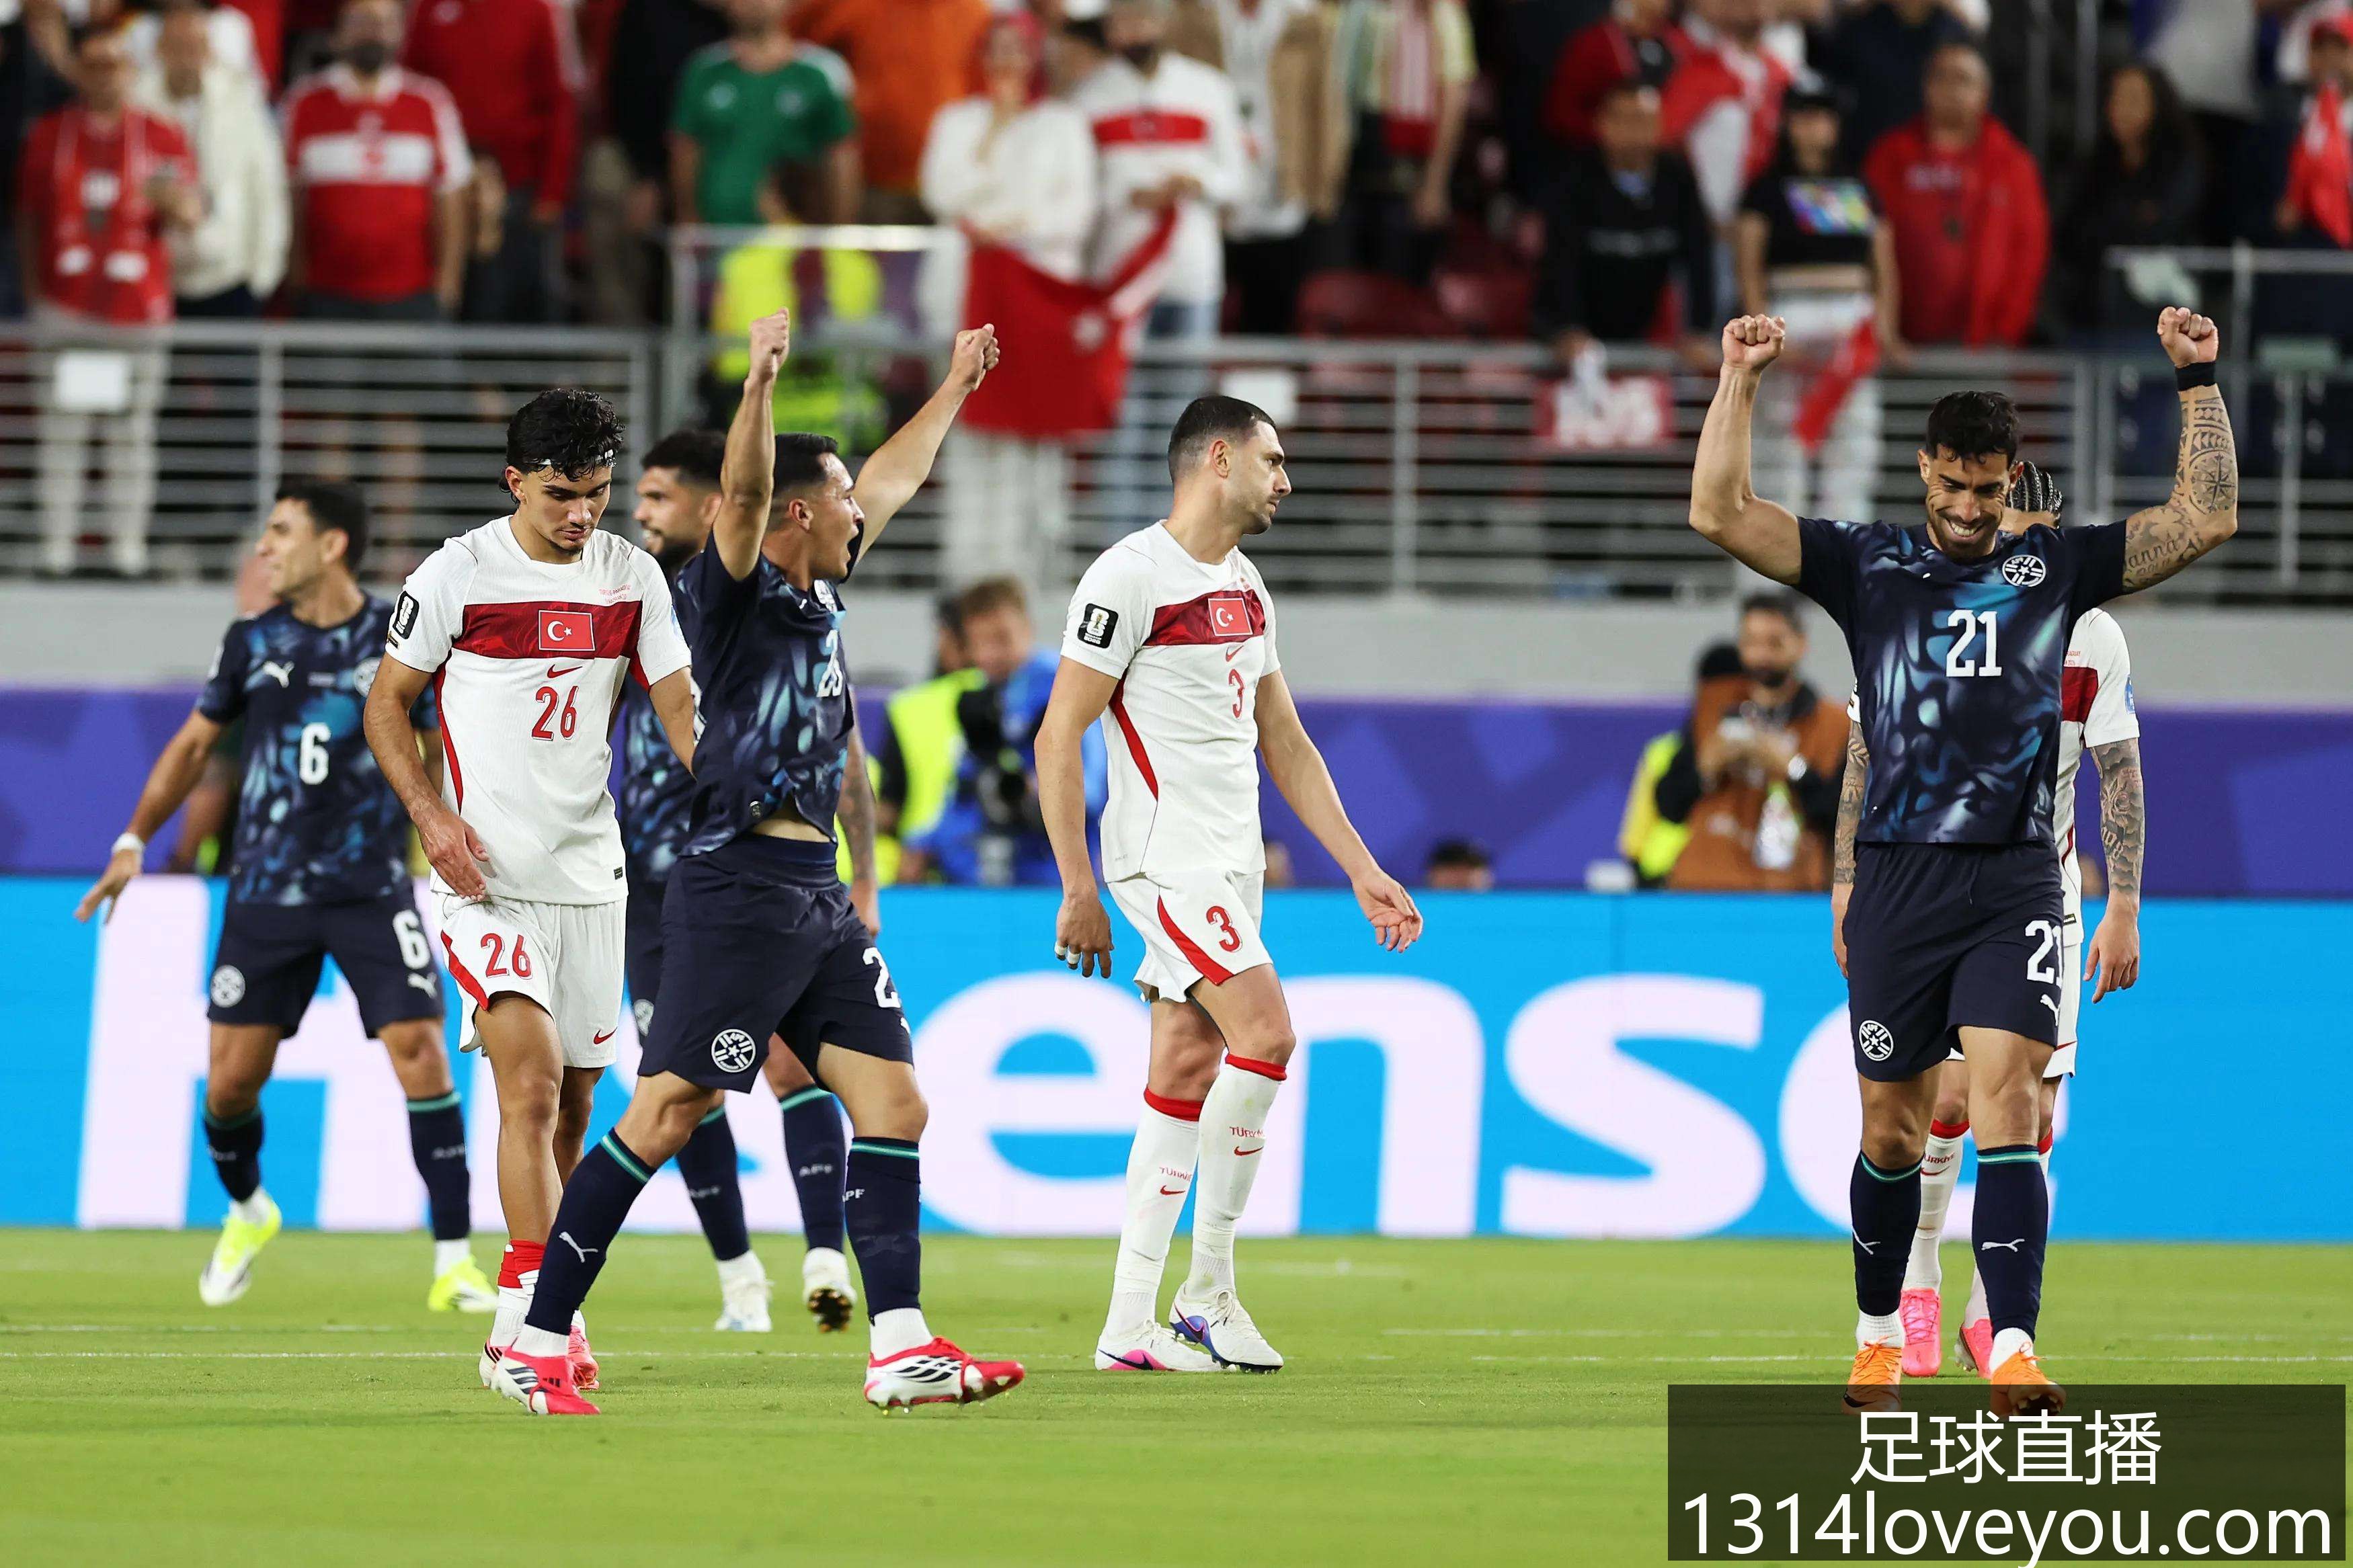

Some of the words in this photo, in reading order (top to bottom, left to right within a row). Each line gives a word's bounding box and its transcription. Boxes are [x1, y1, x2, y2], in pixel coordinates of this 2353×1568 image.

[1946, 609, 2003, 677] 21
[531, 686, 579, 741] 26
[1228, 668, 1245, 720] 3
[299, 722, 331, 785] 6
[392, 909, 431, 969] 6
[480, 932, 533, 979] 26
[1205, 905, 1242, 953] 3
[2025, 919, 2063, 989] 21
[863, 946, 902, 1008] 2
